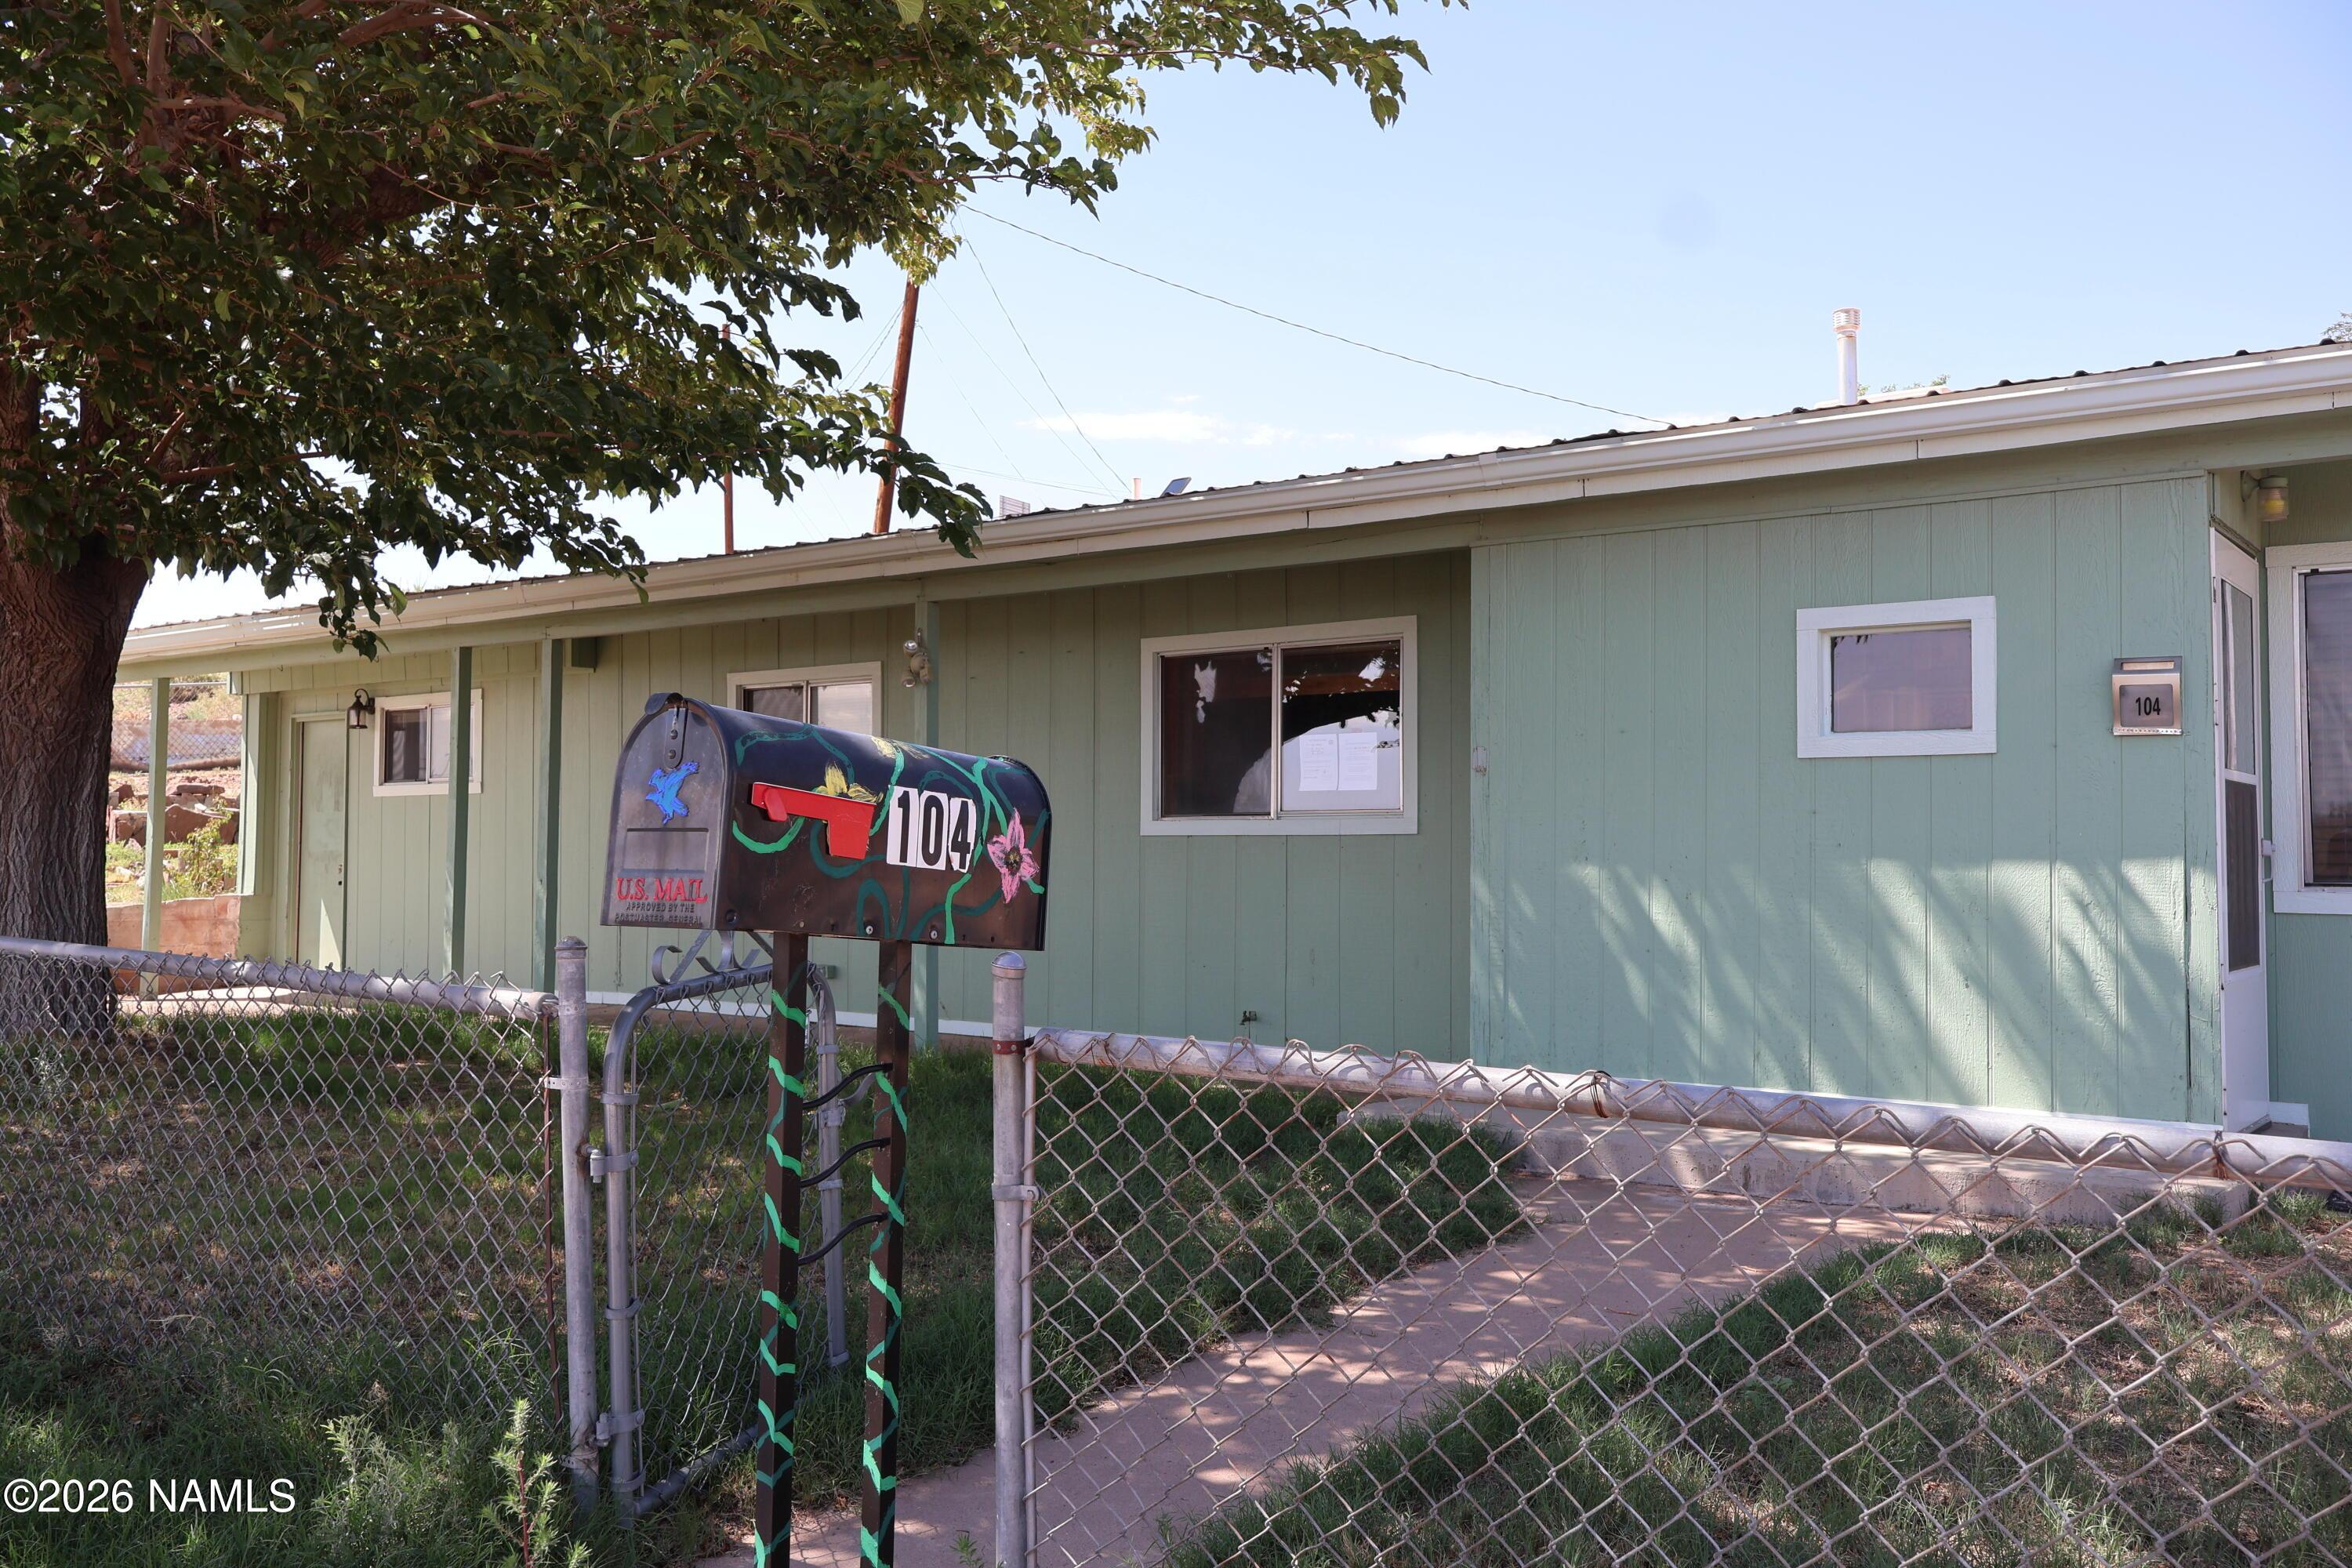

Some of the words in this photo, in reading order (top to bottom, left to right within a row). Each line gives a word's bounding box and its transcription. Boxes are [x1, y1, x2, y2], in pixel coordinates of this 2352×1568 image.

[2135, 696, 2161, 716] 104
[897, 789, 971, 870] 104
[616, 877, 649, 901] U.S.
[654, 877, 709, 903] MAIL
[626, 902, 666, 913] APPROVED
[668, 902, 678, 913] BY
[680, 903, 695, 913] THE
[615, 913, 664, 923] POSTMASTER
[668, 915, 703, 926] GENERAL
